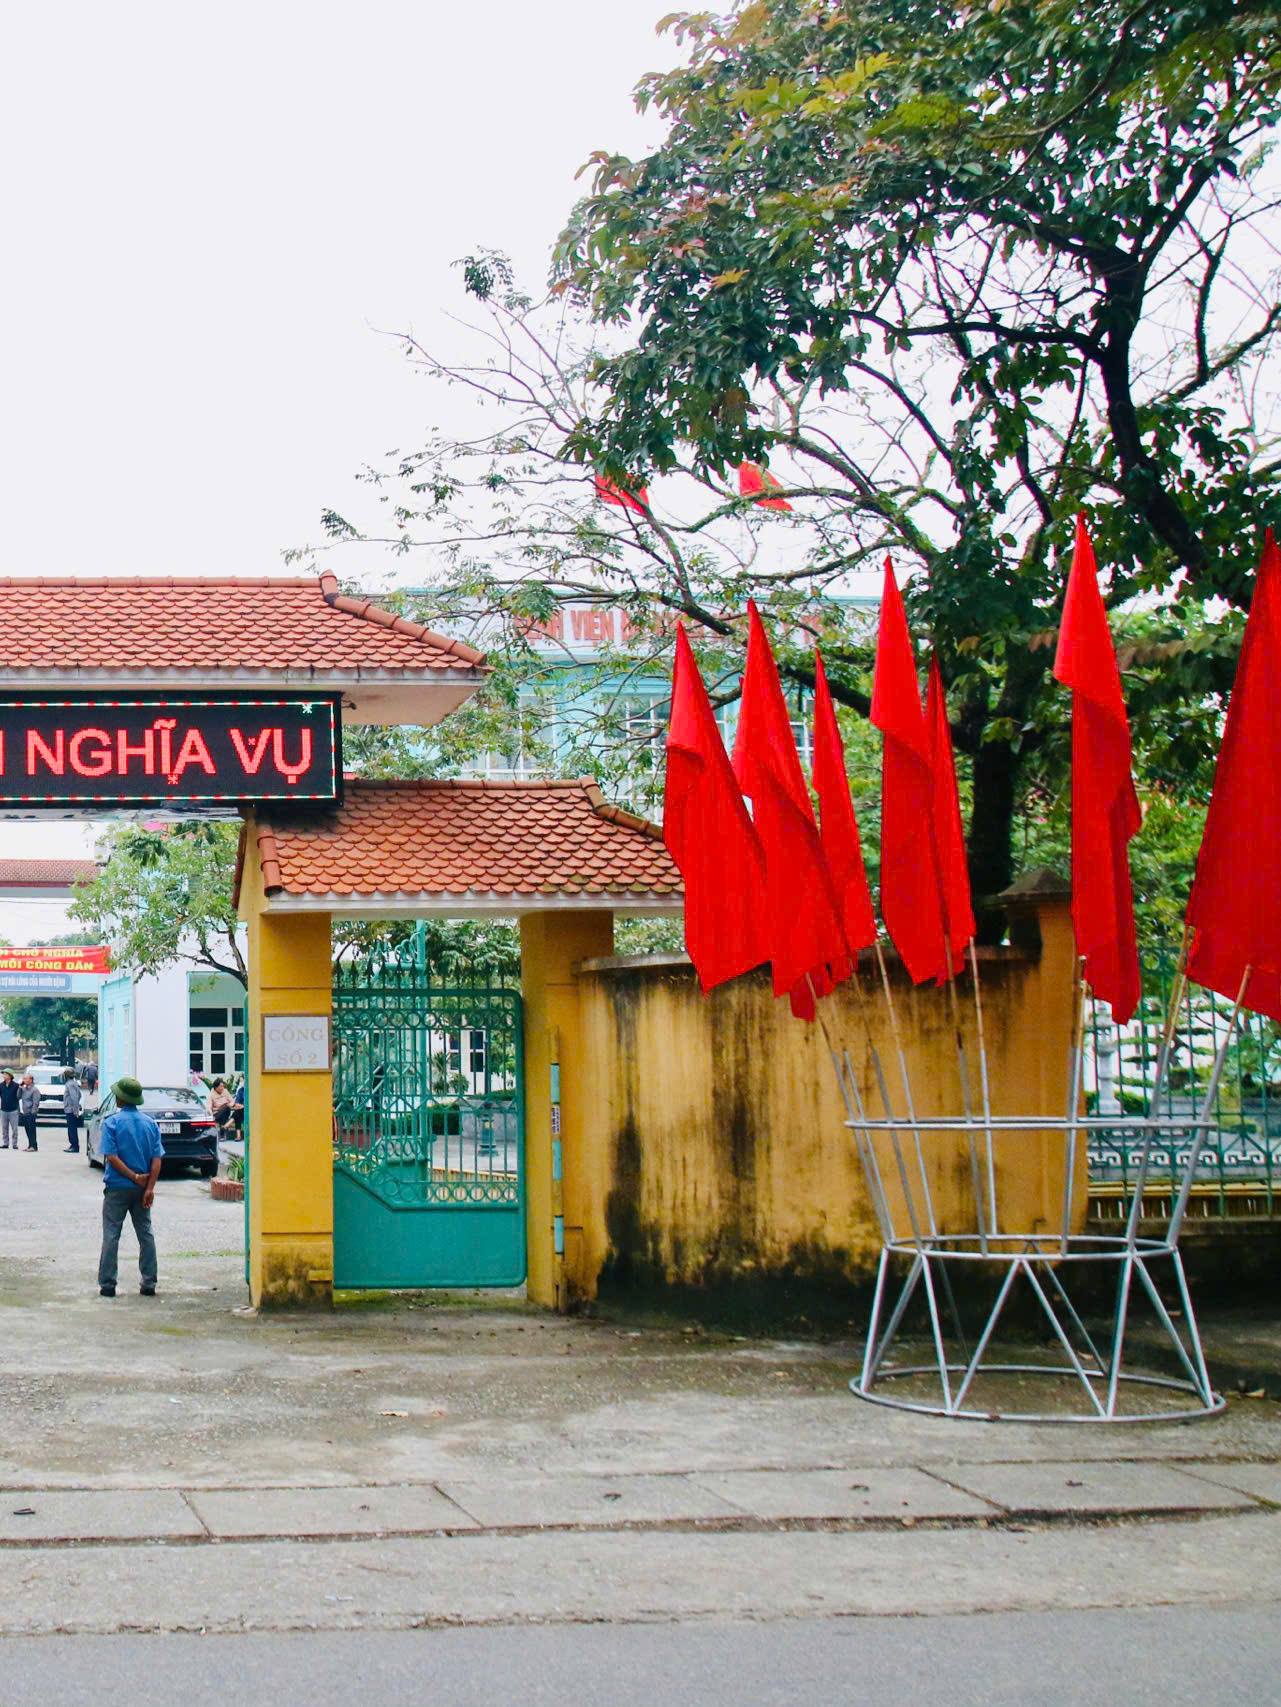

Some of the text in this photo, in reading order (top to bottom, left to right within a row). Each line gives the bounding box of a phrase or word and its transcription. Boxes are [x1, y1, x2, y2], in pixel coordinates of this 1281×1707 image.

[26, 718, 217, 777] NGHĨA
[230, 728, 312, 784] VỤ
[26, 959, 62, 969] CÔNG
[66, 959, 94, 970] DÂN
[307, 1052, 317, 1064] 2
